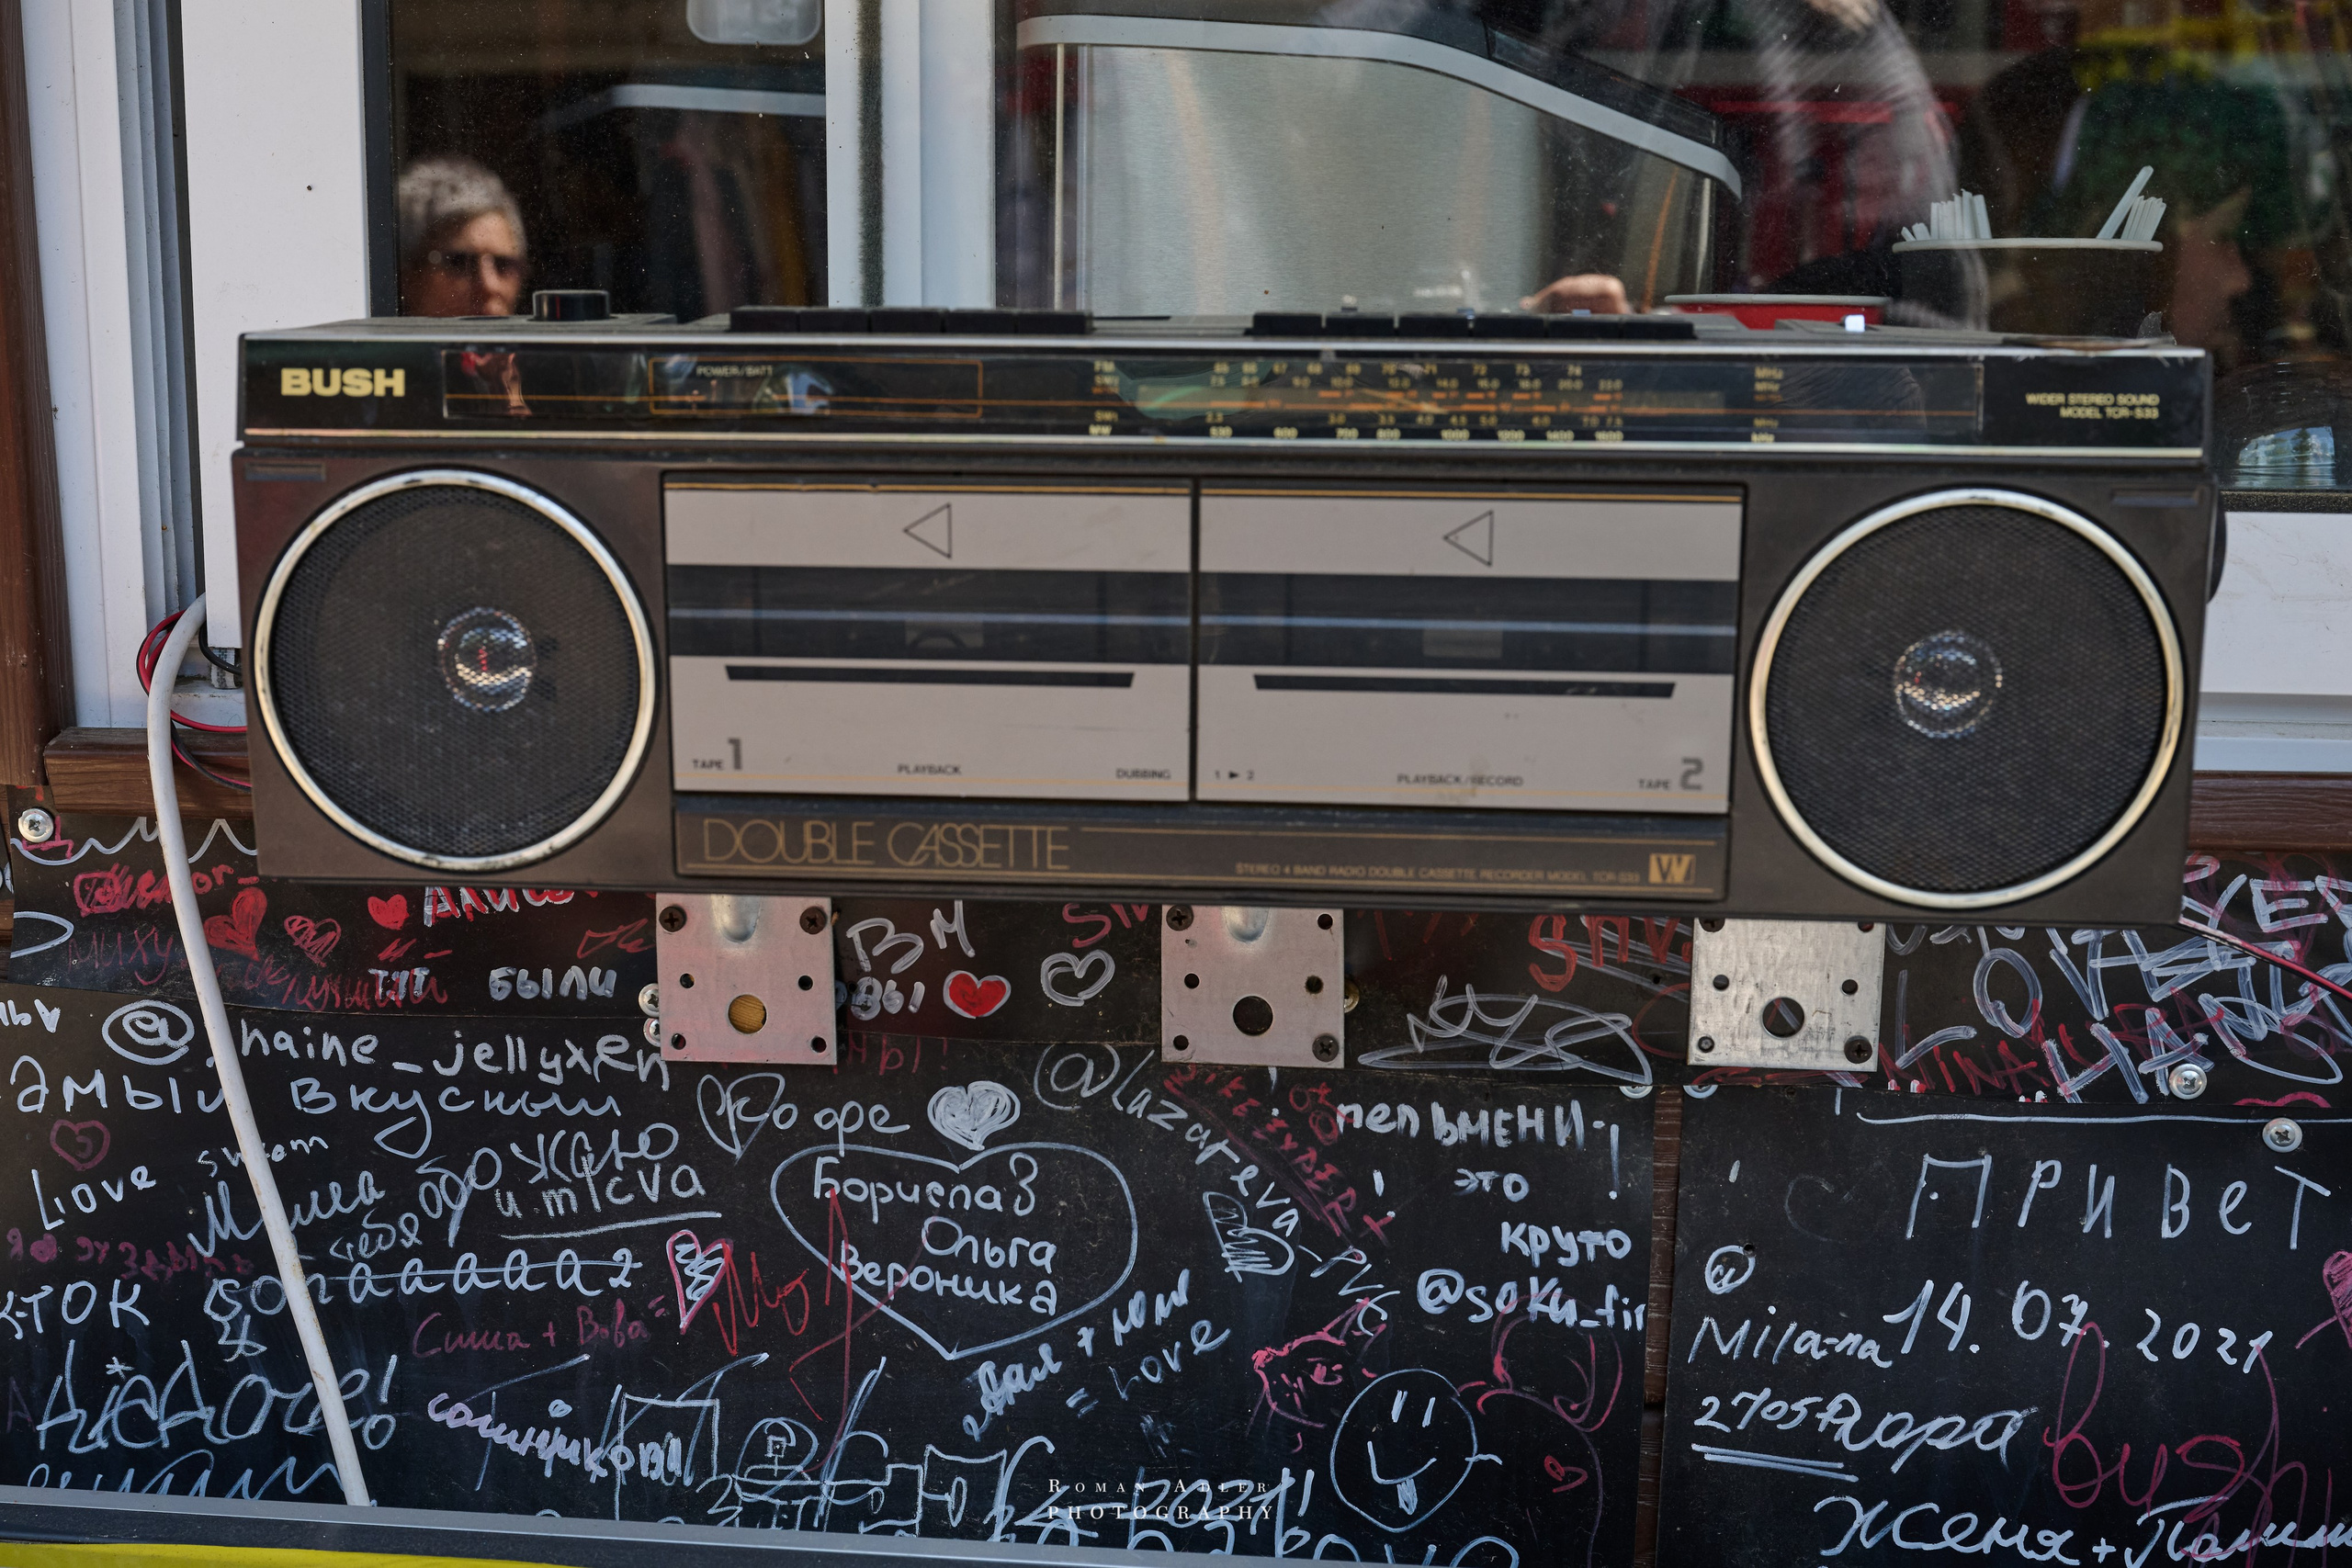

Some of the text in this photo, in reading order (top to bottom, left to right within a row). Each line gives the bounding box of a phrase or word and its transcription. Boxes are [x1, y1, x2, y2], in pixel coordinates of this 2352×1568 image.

[281, 368, 405, 397] BUSH
[2026, 392, 2160, 406] WIDER STEREO SOUND
[2060, 406, 2103, 419] MODEL
[692, 738, 743, 771] TAPE 1
[898, 764, 961, 775] PLAYBACK
[1116, 768, 1171, 781] DUBBING
[1637, 756, 1705, 791] TAPE 2
[702, 818, 1070, 871] DOUBLE CASSETTE
[1235, 863, 1281, 875] STEREO
[1293, 864, 1327, 876] BAND
[1329, 865, 1366, 877] RADIO
[1367, 866, 1416, 878] DOUBLE
[1419, 867, 1477, 880] CASSETTE
[1479, 868, 1544, 881] RECORDER
[1545, 870, 1587, 883] MODEL
[922, 1215, 1057, 1275] Ольга
[840, 1239, 1059, 1316] Вероника
[2136, 1307, 2275, 1374] 2021
